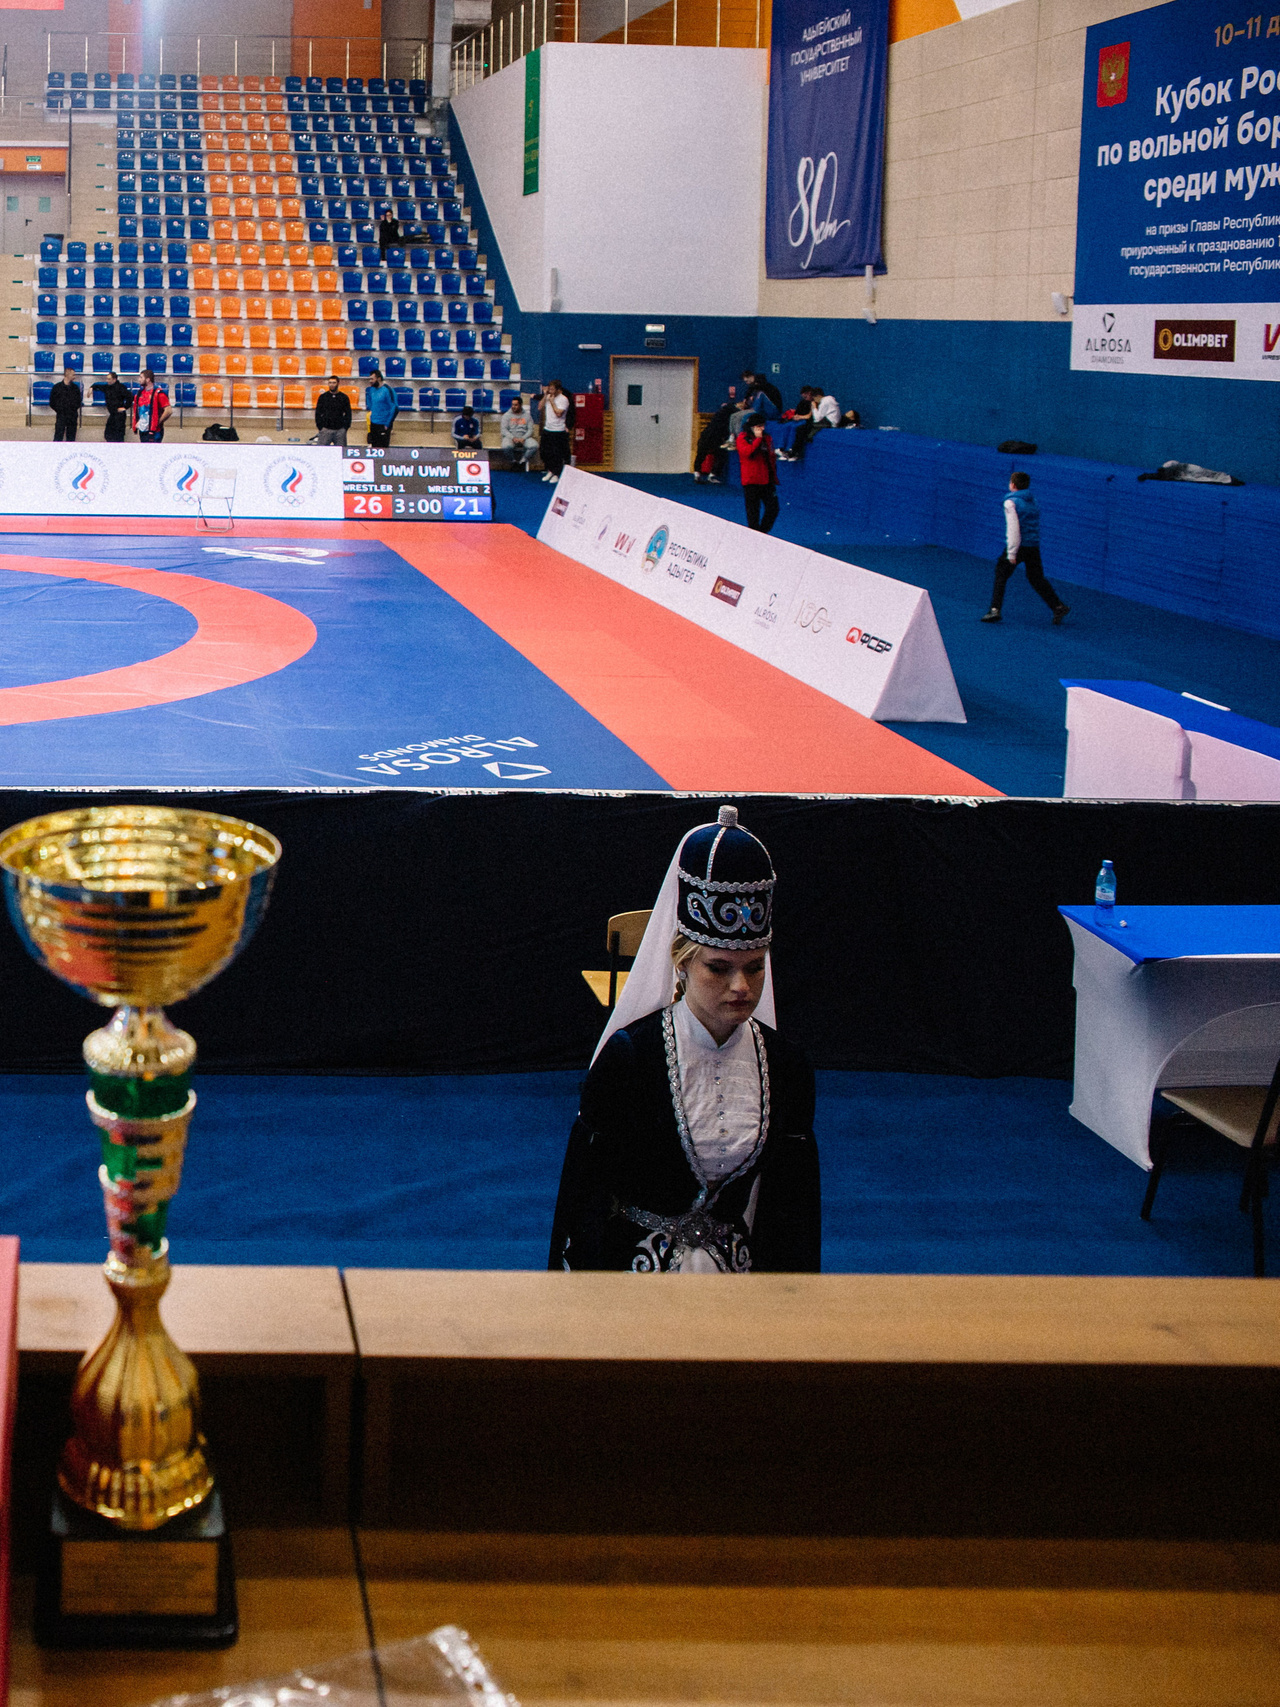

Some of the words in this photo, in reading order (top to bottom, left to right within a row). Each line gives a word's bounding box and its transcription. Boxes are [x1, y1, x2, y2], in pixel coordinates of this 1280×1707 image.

[802, 9, 851, 42] АДЫГЕЙСКИЙ
[790, 26, 862, 66] ГОСУДАРСТВЕННЫЙ
[800, 55, 851, 87] УНИВЕРСИТЕТ
[1156, 76, 1233, 123] Кубок
[1240, 66, 1280, 100] Ро
[1097, 143, 1122, 167] по
[1128, 116, 1229, 162] вольной
[1144, 171, 1218, 208] среди
[1145, 226, 1157, 236] на
[1159, 223, 1188, 237] призы
[1190, 219, 1221, 232] Главы
[1121, 241, 1187, 260] приуроченный
[1189, 245, 1195, 253] к
[1197, 237, 1275, 255] празднованию
[1129, 262, 1221, 279] государственности
[1085, 338, 1132, 353] ALROSA
[1173, 333, 1228, 349] OLIMPBET
[1091, 355, 1124, 364] DIAMONDS
[347, 449, 360, 457] FS
[366, 449, 385, 457] 120
[452, 450, 477, 458] Tour
[382, 465, 414, 477] UWW
[419, 465, 450, 477] UWW
[343, 484, 393, 492] WRESTLER
[428, 485, 479, 494] WRESTLER
[484, 486, 490, 494] 2
[353, 496, 383, 514] 26
[394, 499, 442, 514] 3:00
[453, 498, 483, 516] 21
[668, 542, 709, 570] РЕСПУБЛИКА
[667, 562, 696, 584] АДЫГЕЯ
[860, 632, 894, 654] ФСБР
[356, 736, 539, 776] ALROSA
[358, 734, 486, 762] DIAMONDS
